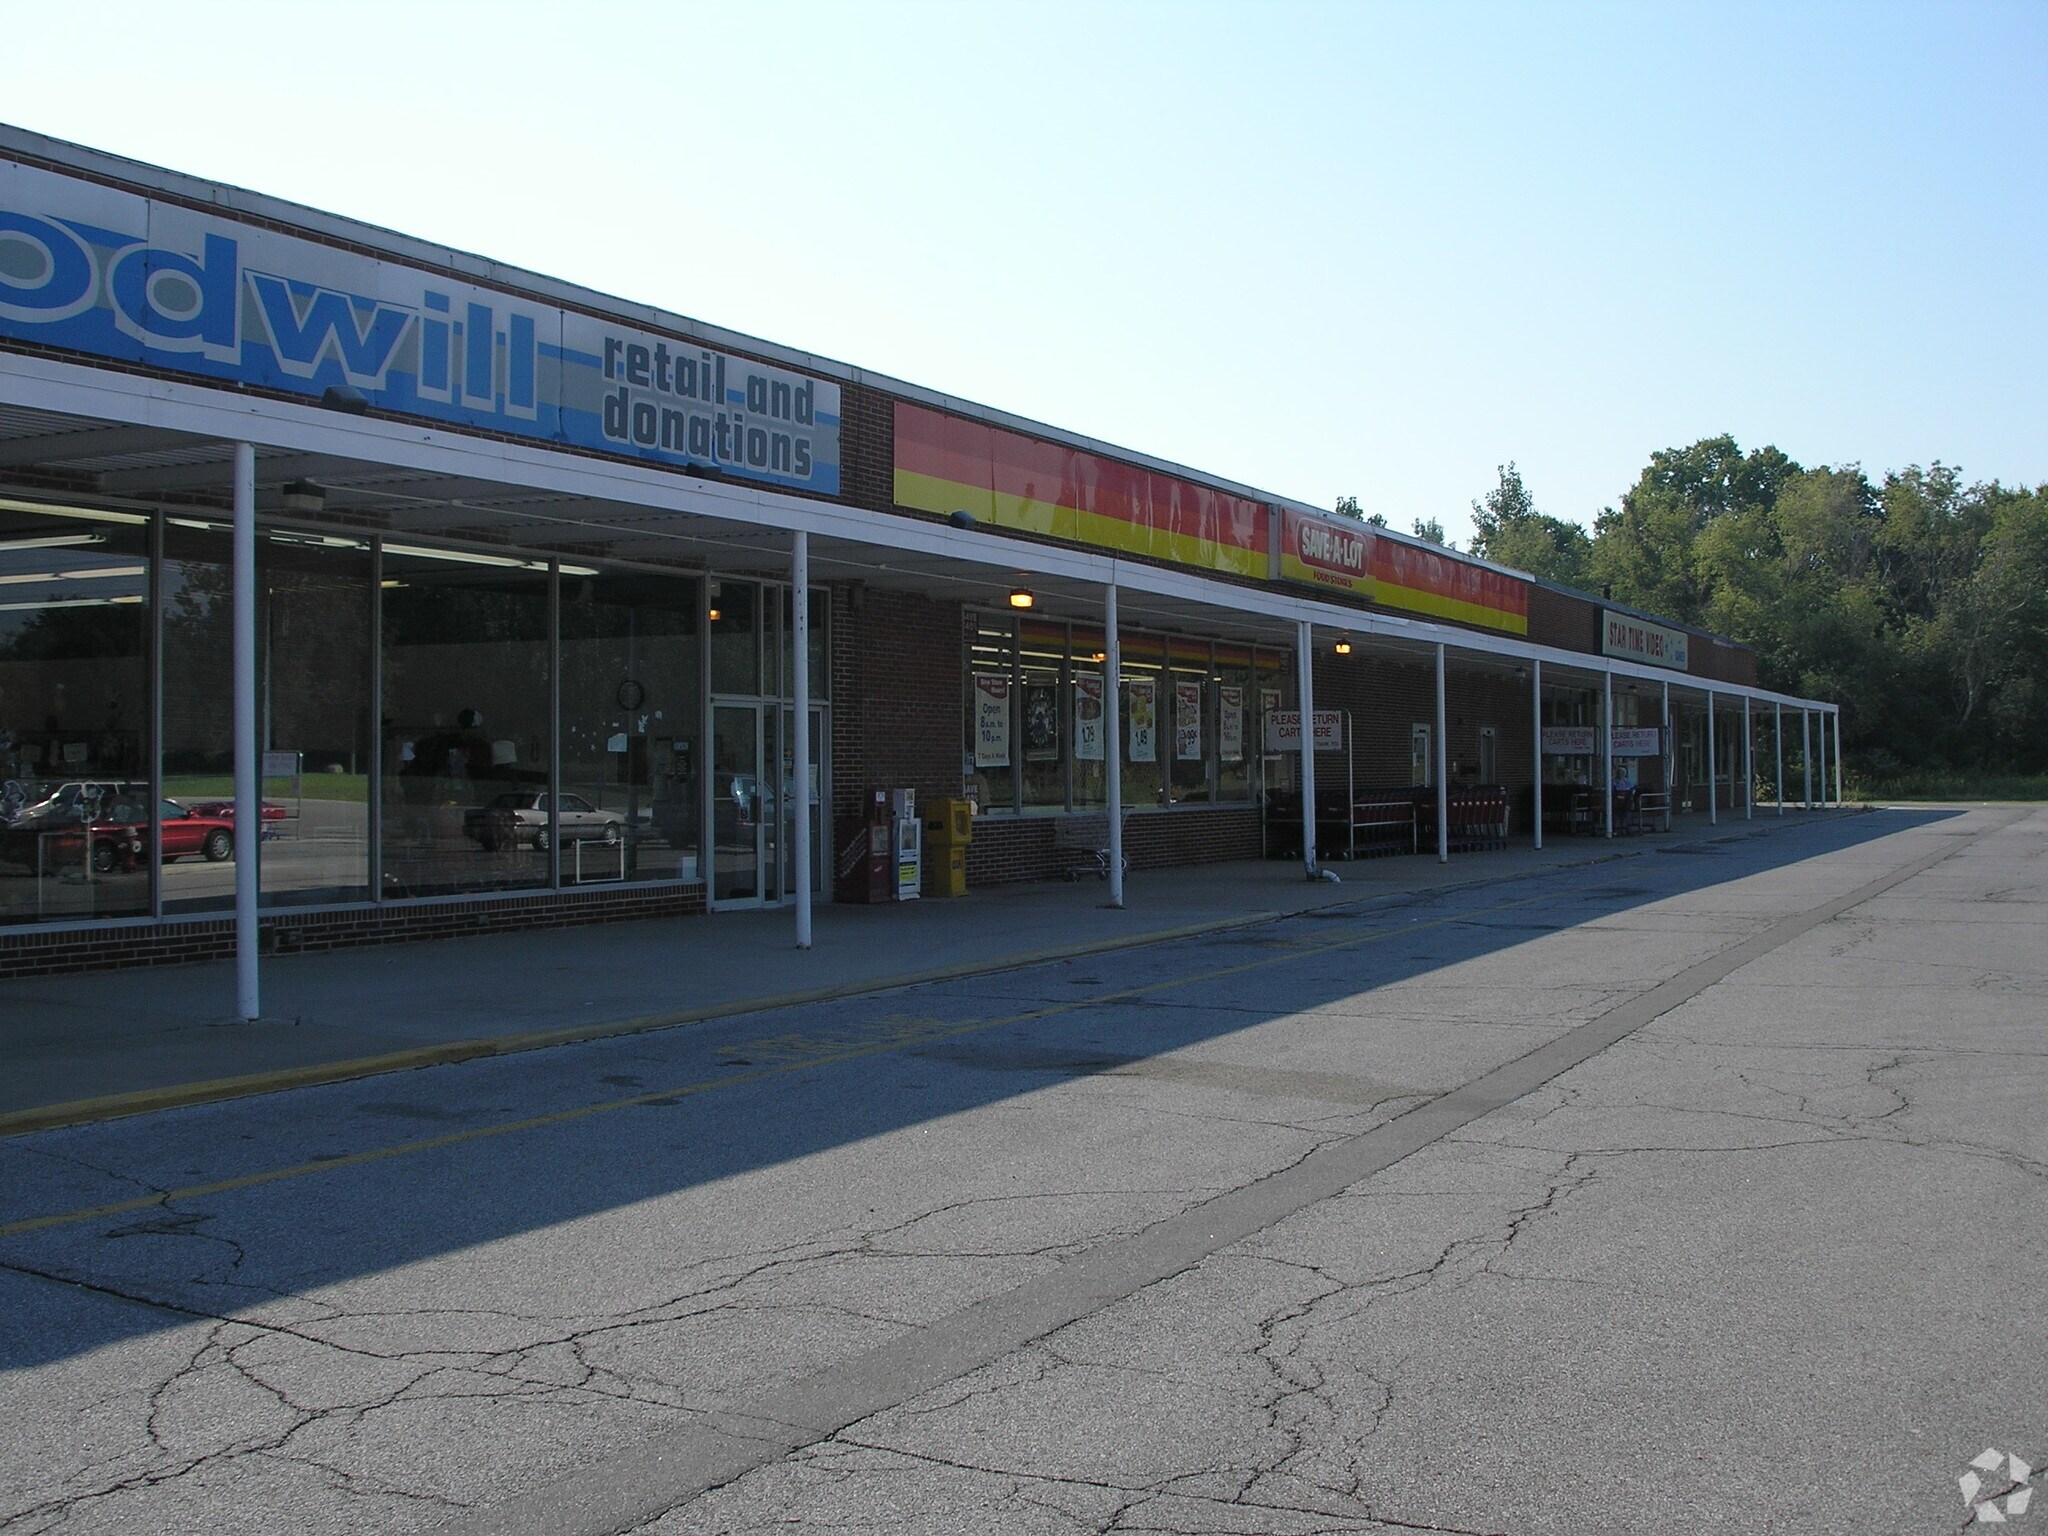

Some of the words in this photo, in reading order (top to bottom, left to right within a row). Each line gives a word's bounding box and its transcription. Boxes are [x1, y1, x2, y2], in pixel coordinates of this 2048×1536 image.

[604, 336, 725, 406] retail
[747, 374, 814, 427] and
[603, 386, 811, 476] donations
[1313, 570, 1330, 583] FOOD
[1330, 575, 1353, 588] STORES
[1609, 621, 1626, 648] STAR
[1628, 627, 1643, 653] TIME
[1646, 632, 1664, 658] VIDEO
[983, 703, 1000, 716] Open
[1271, 714, 1301, 724] PLEASE
[1313, 714, 1339, 724] ETURN
[1279, 727, 1301, 737] CART
[1611, 730, 1630, 739] LEASE
